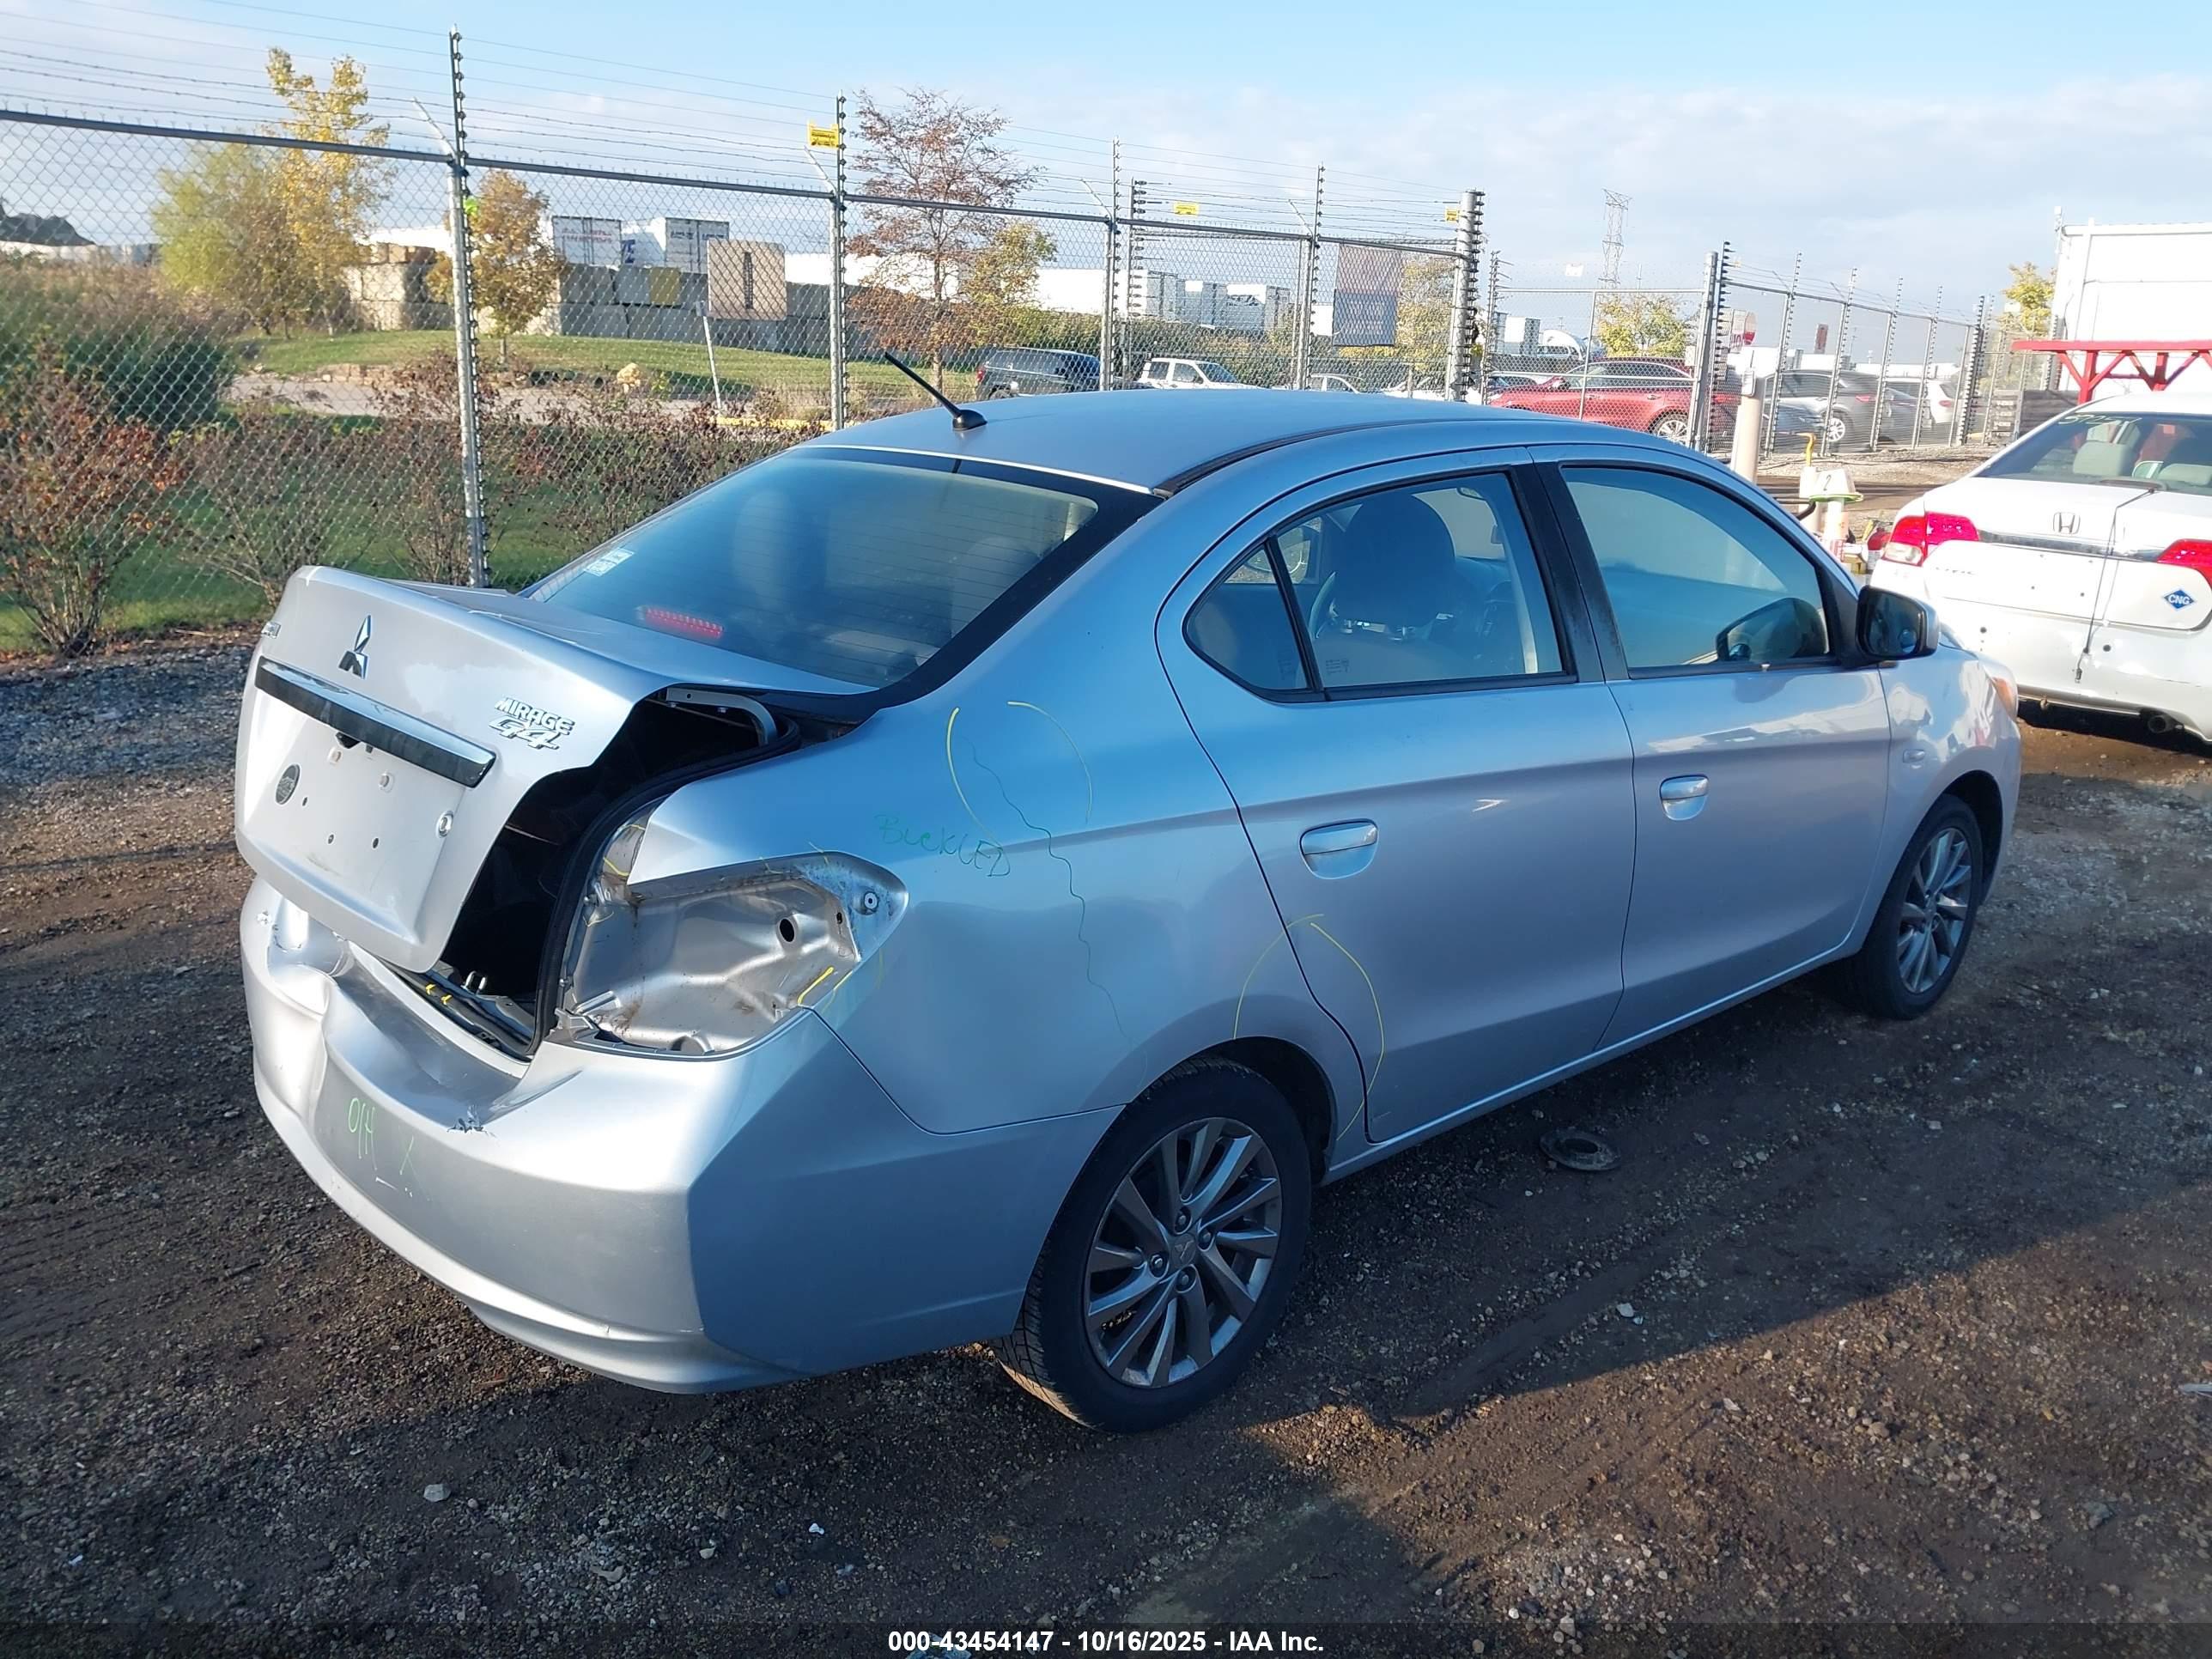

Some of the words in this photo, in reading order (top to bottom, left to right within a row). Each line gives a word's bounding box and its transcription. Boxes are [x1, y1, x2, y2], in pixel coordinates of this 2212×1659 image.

[2167, 594, 2191, 605] CNG
[488, 714, 560, 750] G4
[494, 696, 575, 736] MIRAGE
